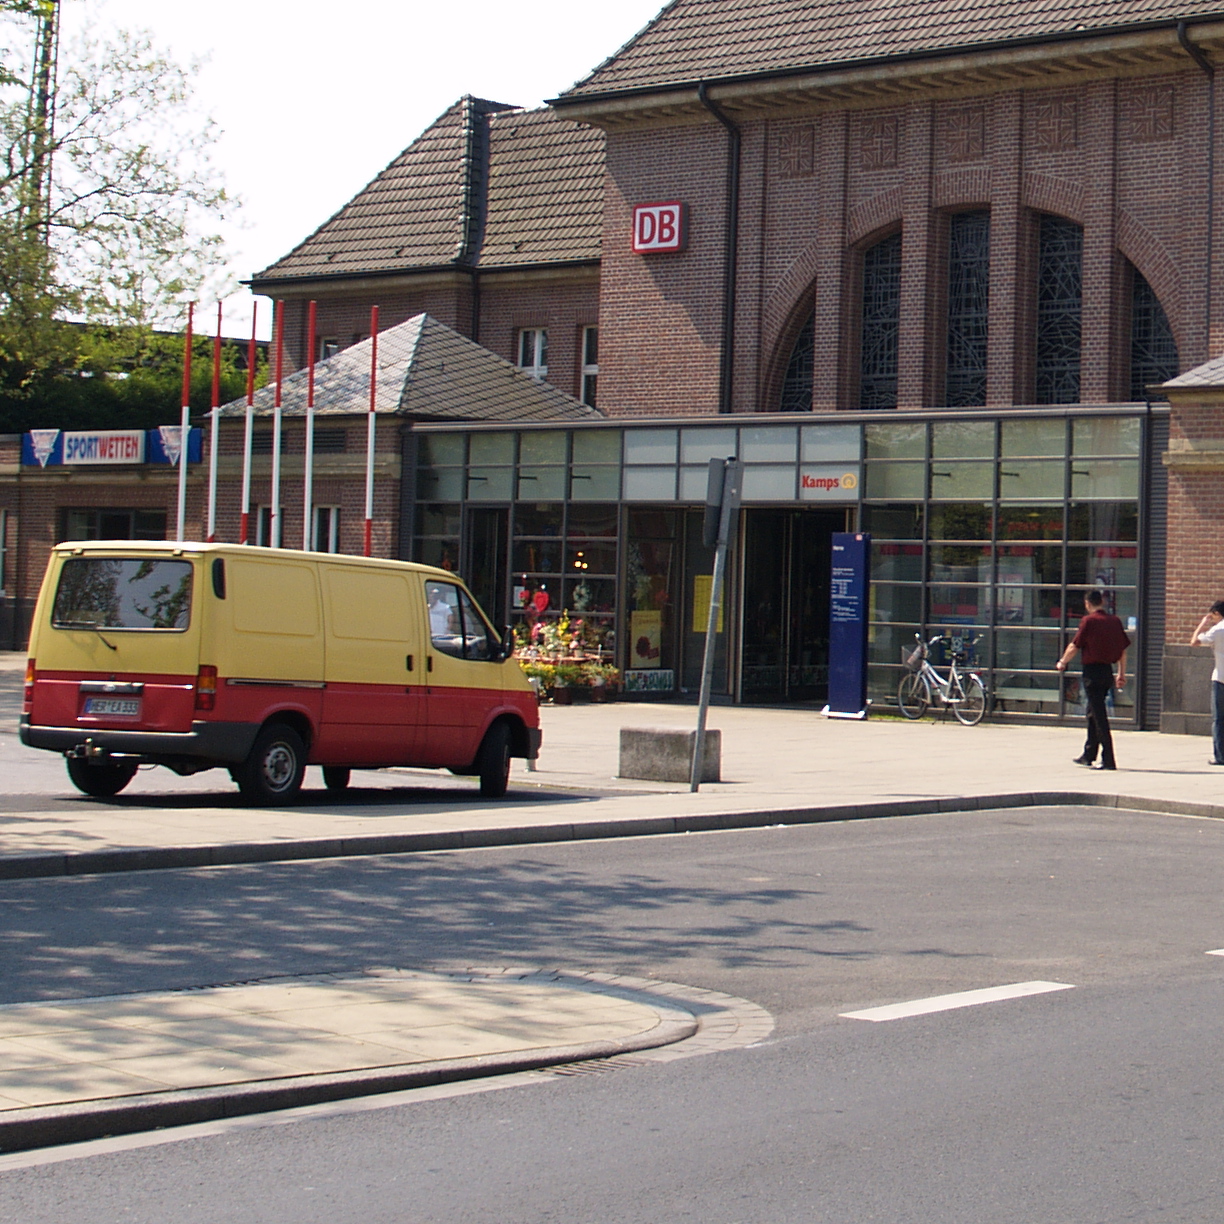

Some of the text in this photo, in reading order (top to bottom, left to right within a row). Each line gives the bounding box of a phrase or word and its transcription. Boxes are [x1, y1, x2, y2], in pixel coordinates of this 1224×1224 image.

[638, 209, 676, 245] DB
[66, 435, 139, 459] SPORTWETTEN
[802, 475, 839, 491] Kamps
